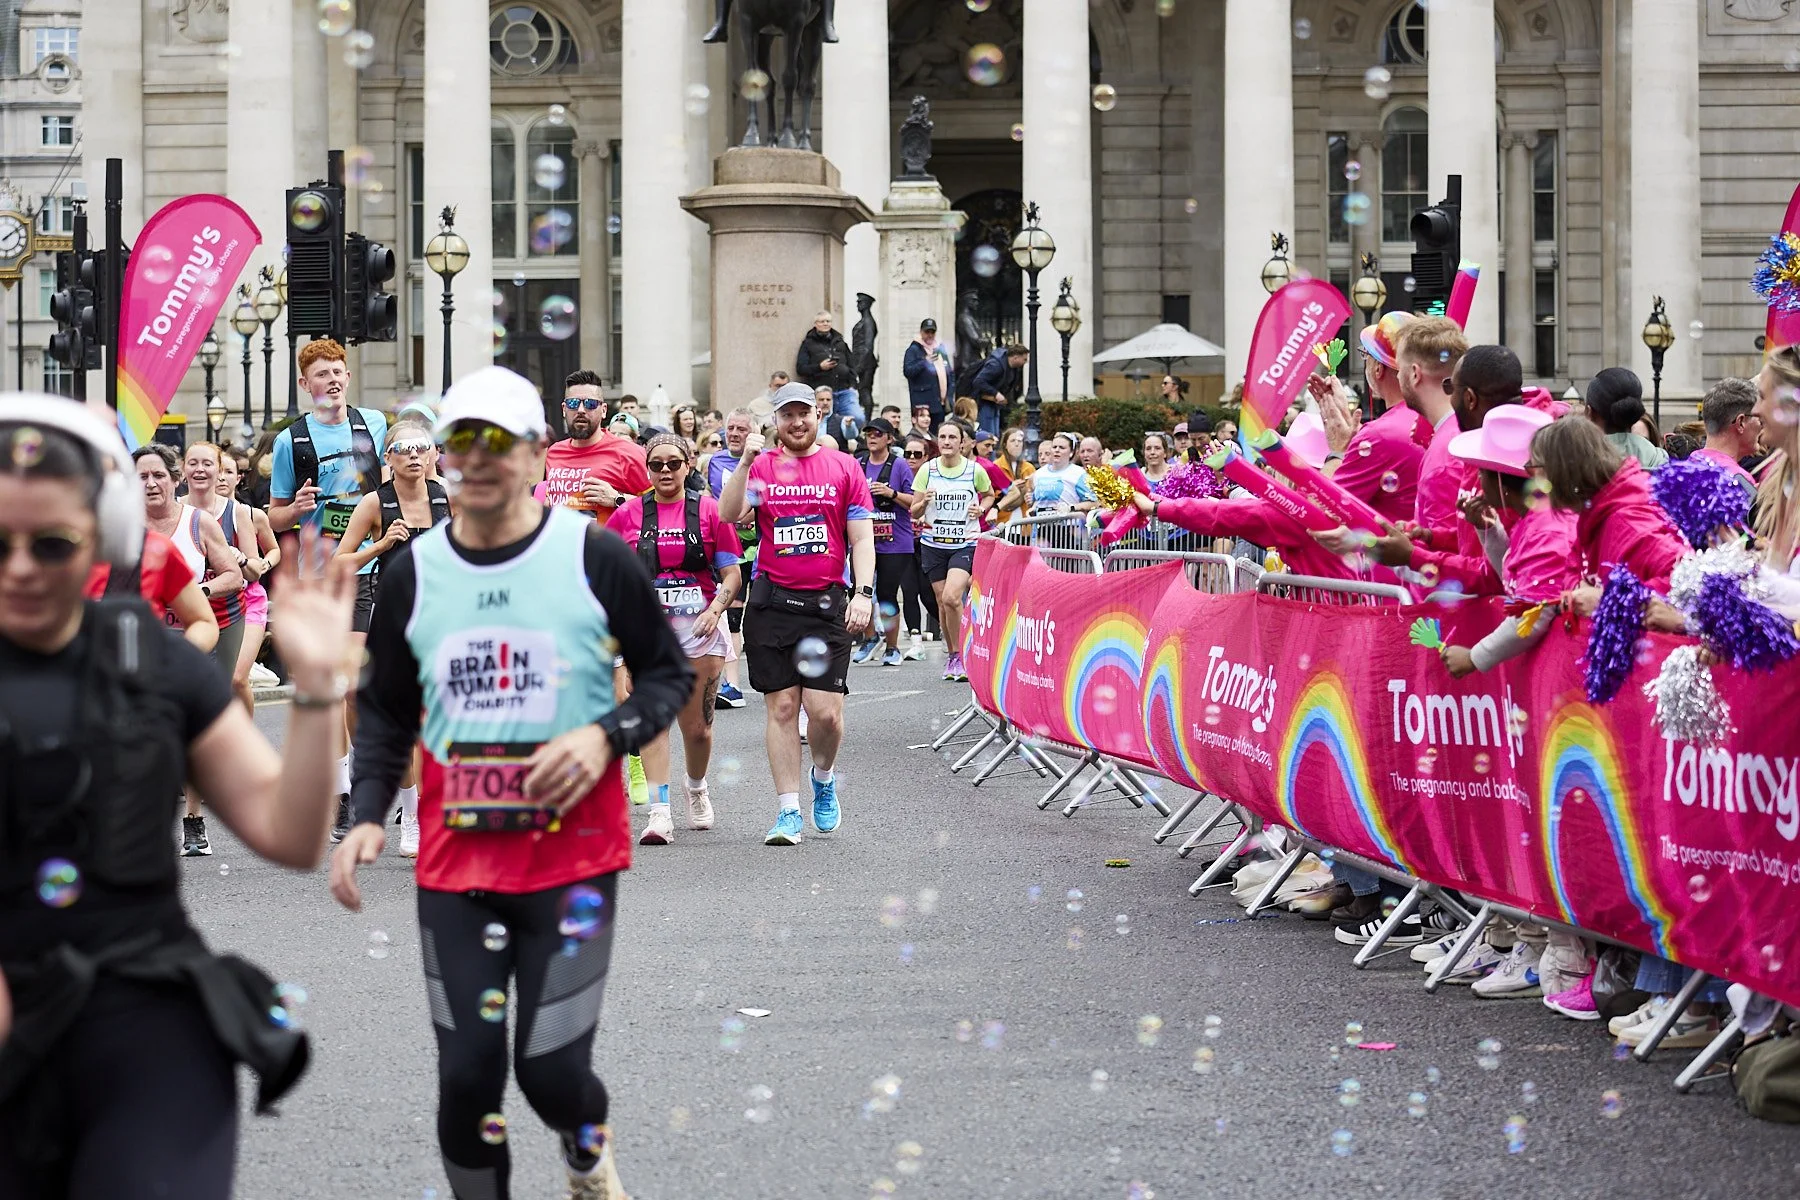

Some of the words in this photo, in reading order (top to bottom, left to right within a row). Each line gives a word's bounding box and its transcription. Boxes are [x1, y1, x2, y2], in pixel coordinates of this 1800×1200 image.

[137, 225, 221, 347] Tommy's
[166, 344, 179, 359] The
[176, 303, 203, 345] pregnancy
[199, 286, 210, 304] and
[207, 266, 223, 287] baby
[219, 239, 239, 266] charity
[739, 284, 793, 292] ERECTED
[746, 298, 775, 306] JUNE
[1257, 301, 1324, 387] Tommy's
[547, 467, 592, 481] BREAST
[767, 483, 837, 499] Tommy's
[1263, 484, 1308, 519] Tommy's
[330, 514, 351, 528] 65
[778, 526, 825, 542] 11765
[936, 526, 964, 536] 19143
[477, 589, 510, 611] IAN
[1193, 722, 1202, 742] The
[1202, 730, 1231, 753] pregnancy
[450, 767, 527, 799] 1704
[1390, 771, 1408, 791] The
[1410, 778, 1467, 801] pregnancy
[1468, 777, 1491, 798] and
[1661, 730, 1800, 842] Tommy
[1660, 835, 1678, 861] The
[1760, 850, 1789, 886] baby
